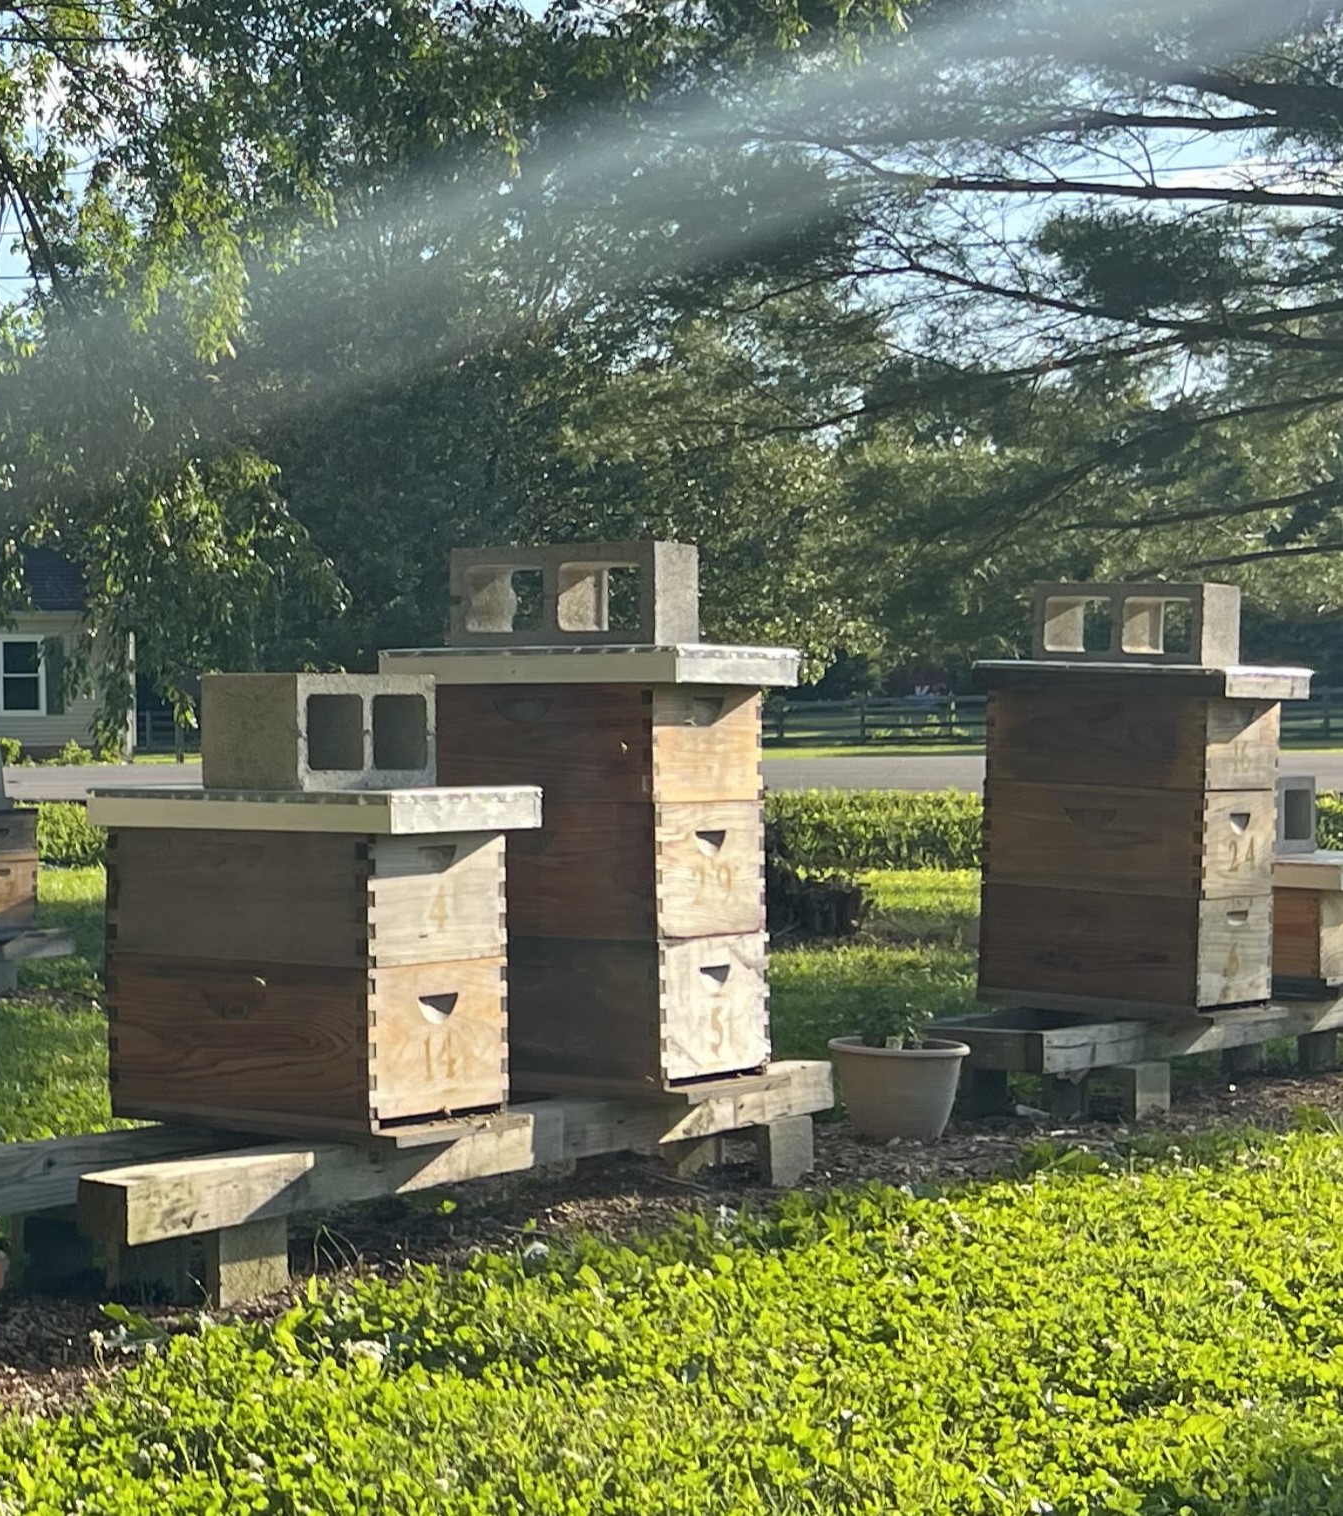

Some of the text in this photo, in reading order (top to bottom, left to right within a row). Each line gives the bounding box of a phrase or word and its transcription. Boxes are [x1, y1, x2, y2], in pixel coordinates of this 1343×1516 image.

[1228, 836, 1255, 873] 24
[429, 884, 449, 930] 4
[424, 1033, 457, 1081] 14
